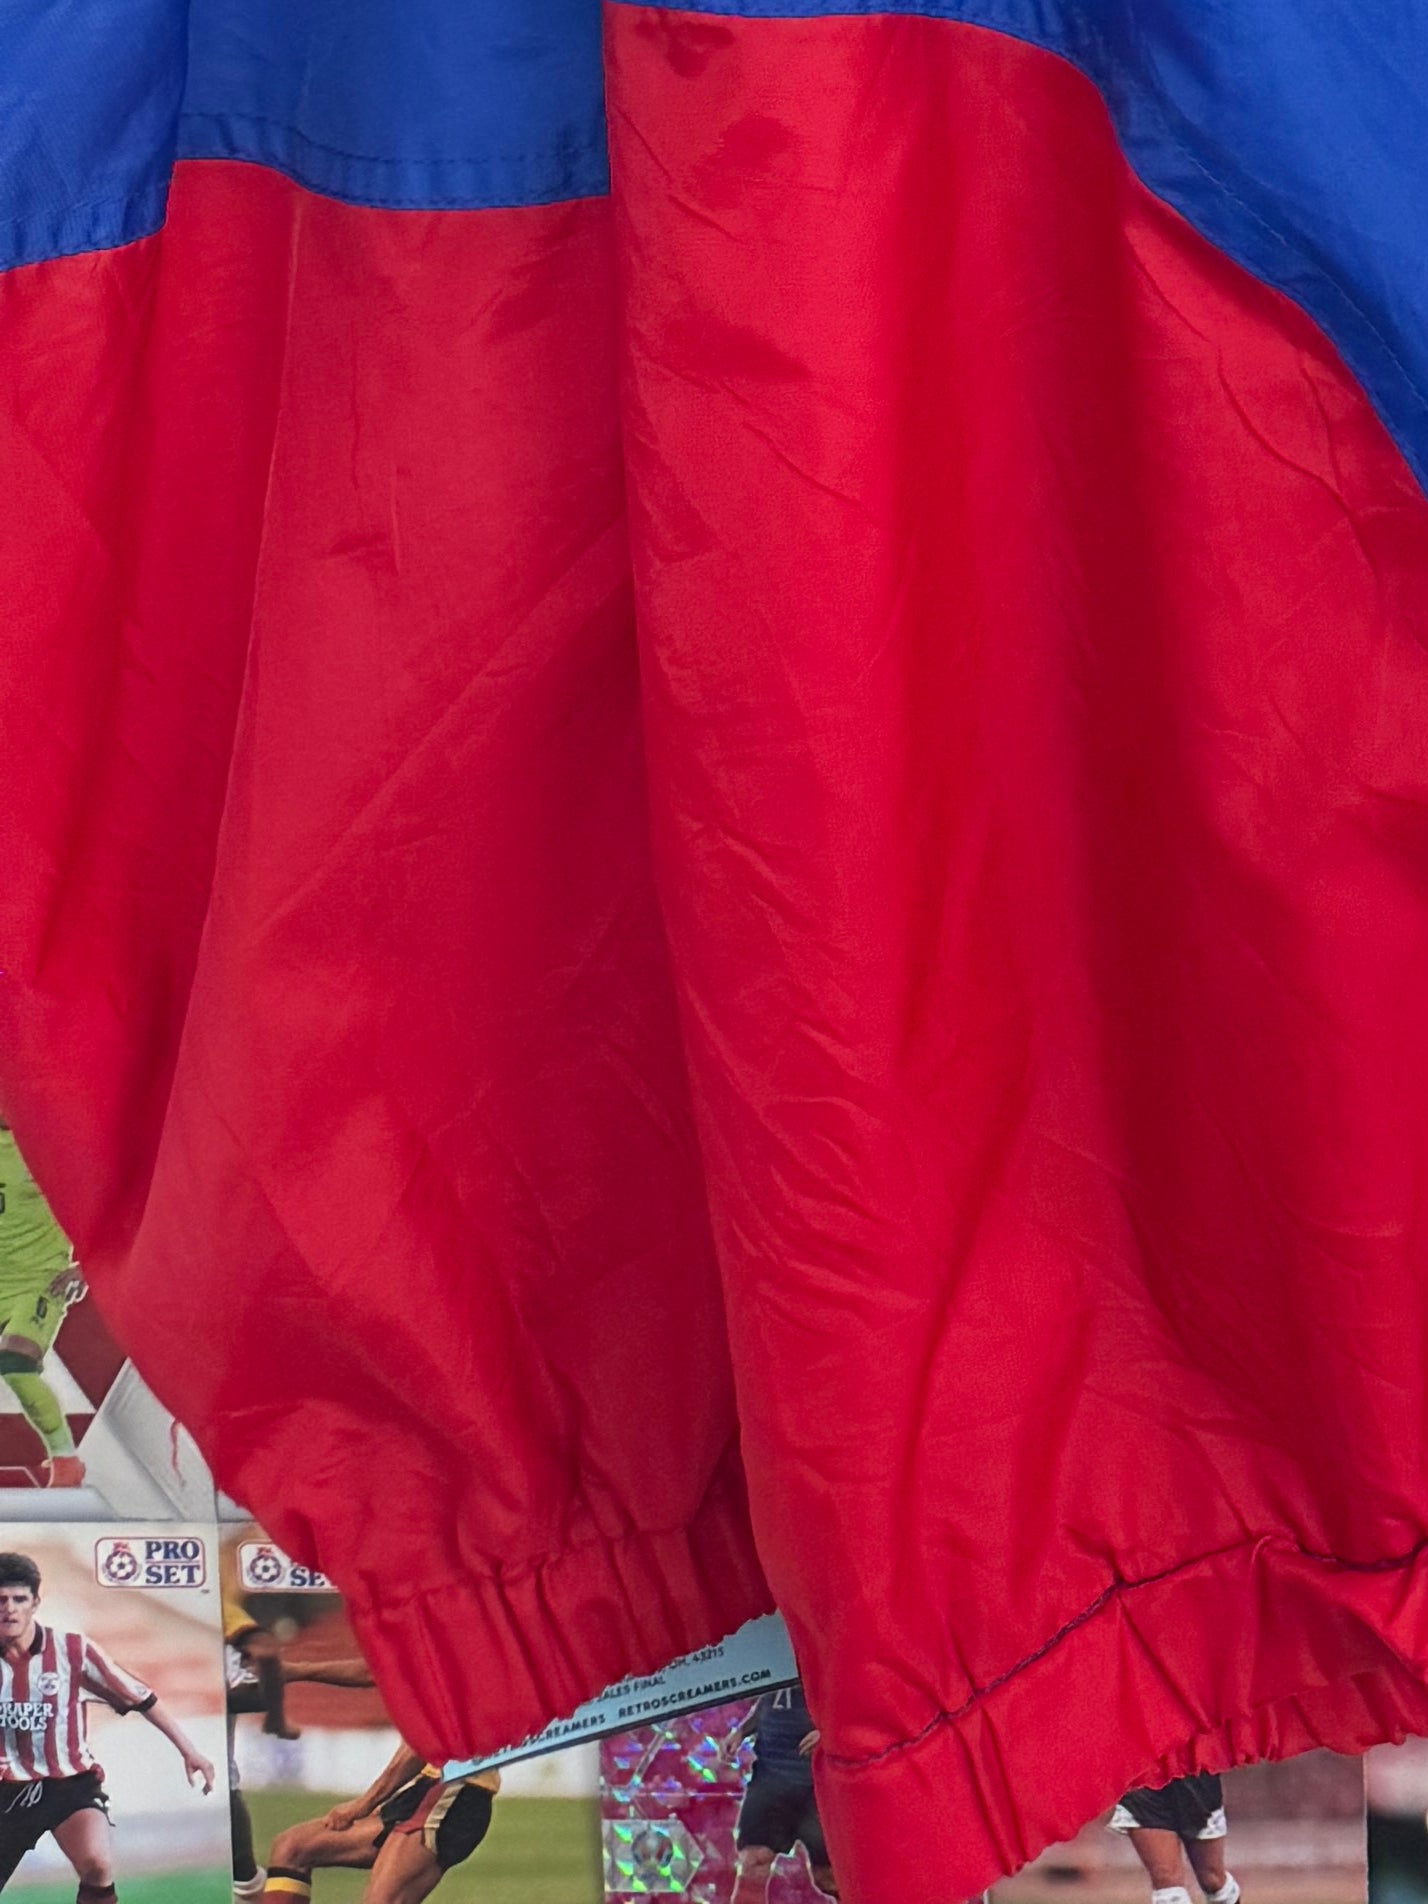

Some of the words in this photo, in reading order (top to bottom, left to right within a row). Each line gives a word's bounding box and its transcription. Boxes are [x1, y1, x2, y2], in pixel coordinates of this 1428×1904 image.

[145, 1540, 200, 1561] PRO
[145, 1565, 200, 1584] SET
[618, 1668, 771, 1719] RETROSCREAMERS.COM
[634, 1676, 665, 1694] FINAL
